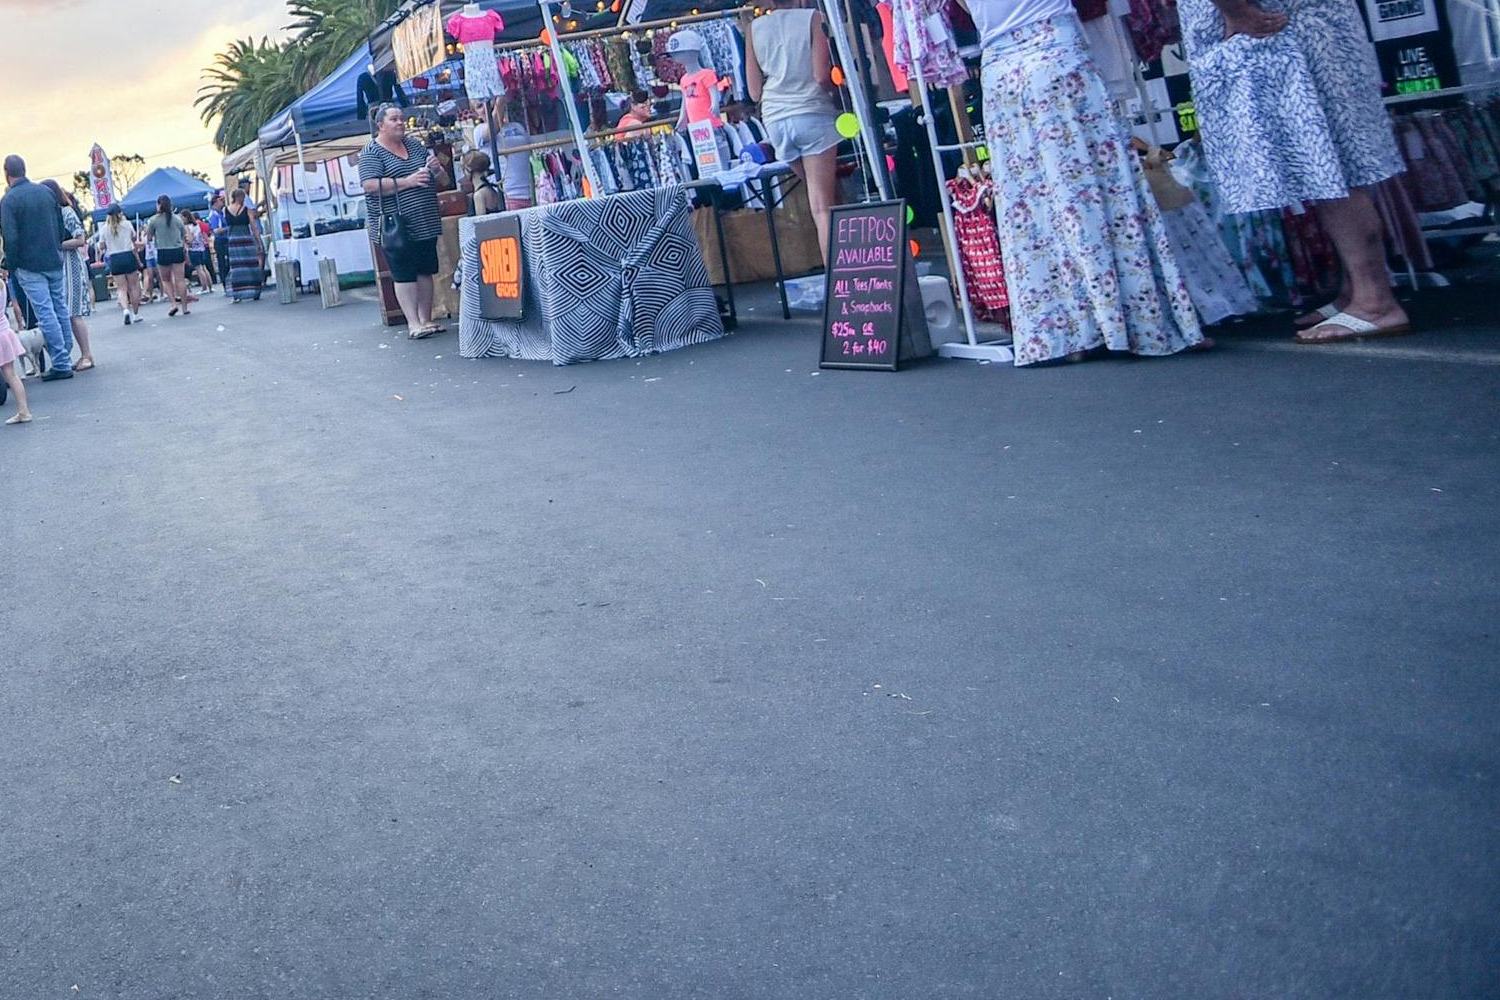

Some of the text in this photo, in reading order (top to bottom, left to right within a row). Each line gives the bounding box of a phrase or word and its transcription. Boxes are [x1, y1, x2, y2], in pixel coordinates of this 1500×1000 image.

[1399, 46, 1428, 65] LIVE
[837, 216, 897, 244] EFTPOS
[480, 236, 518, 285] SHRED
[835, 246, 893, 265] AVAILABLE
[834, 279, 850, 294] ALL
[841, 300, 893, 316] & Snapbacks
[862, 321, 874, 332] OR
[842, 338, 887, 356] 2 for $40
